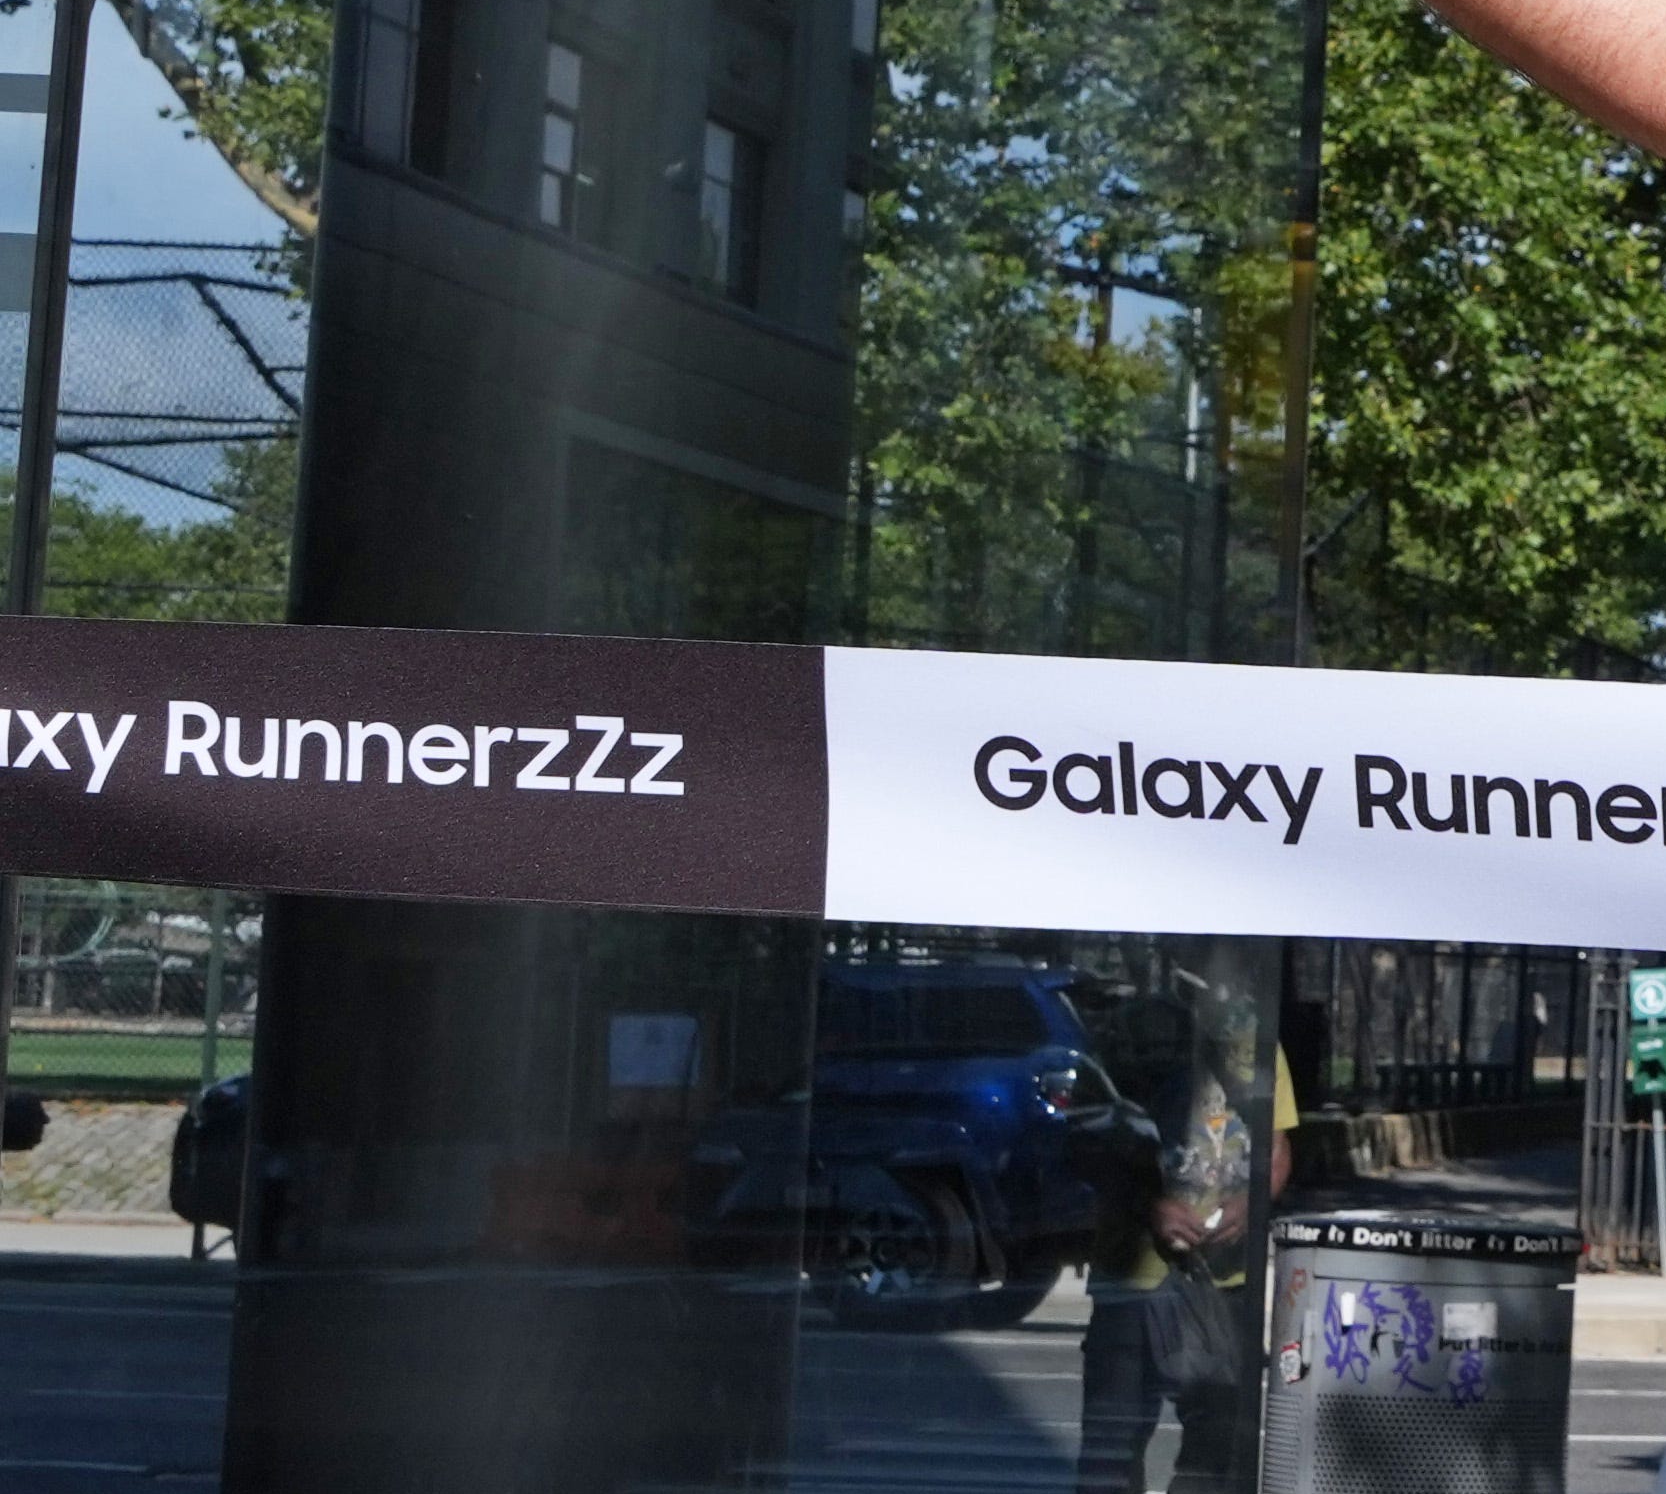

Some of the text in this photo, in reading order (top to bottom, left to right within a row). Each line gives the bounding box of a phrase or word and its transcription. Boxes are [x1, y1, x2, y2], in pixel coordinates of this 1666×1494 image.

[0, 700, 685, 796] xy RunnerzZz
[973, 735, 1324, 845] Galaxy
[1352, 1226, 1413, 1248] Don't
[1421, 1231, 1477, 1251] litter
[1513, 1235, 1558, 1253] Don't
